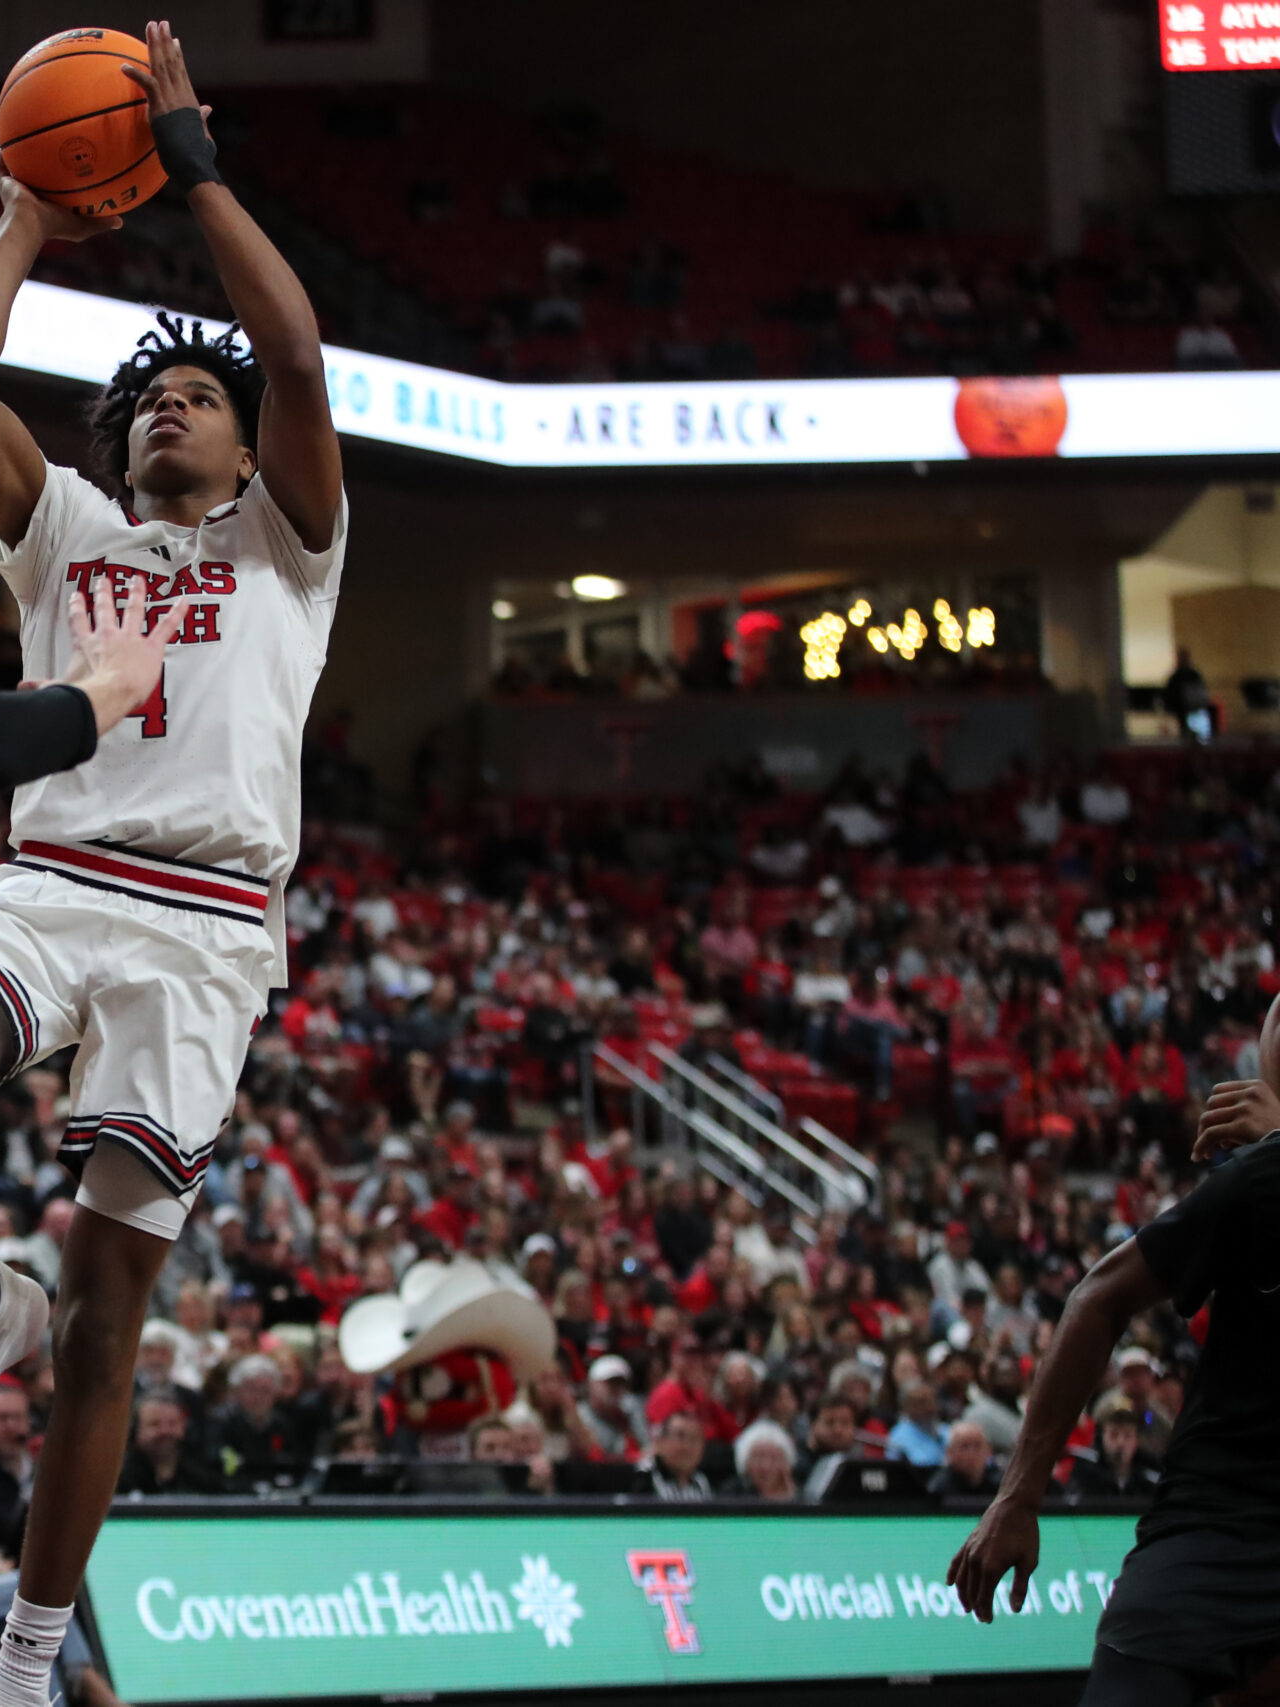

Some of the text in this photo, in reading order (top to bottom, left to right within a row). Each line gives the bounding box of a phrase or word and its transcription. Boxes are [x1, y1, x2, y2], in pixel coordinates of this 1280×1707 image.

[394, 379, 507, 445] BALLS
[566, 403, 646, 447] ARE
[673, 401, 788, 446] BACK
[66, 556, 237, 603] TEXAS
[136, 1571, 514, 1642] CovenantHealth
[760, 1572, 895, 1621] Official
[1049, 1569, 1083, 1614] of
[1085, 1570, 1117, 1611] T
